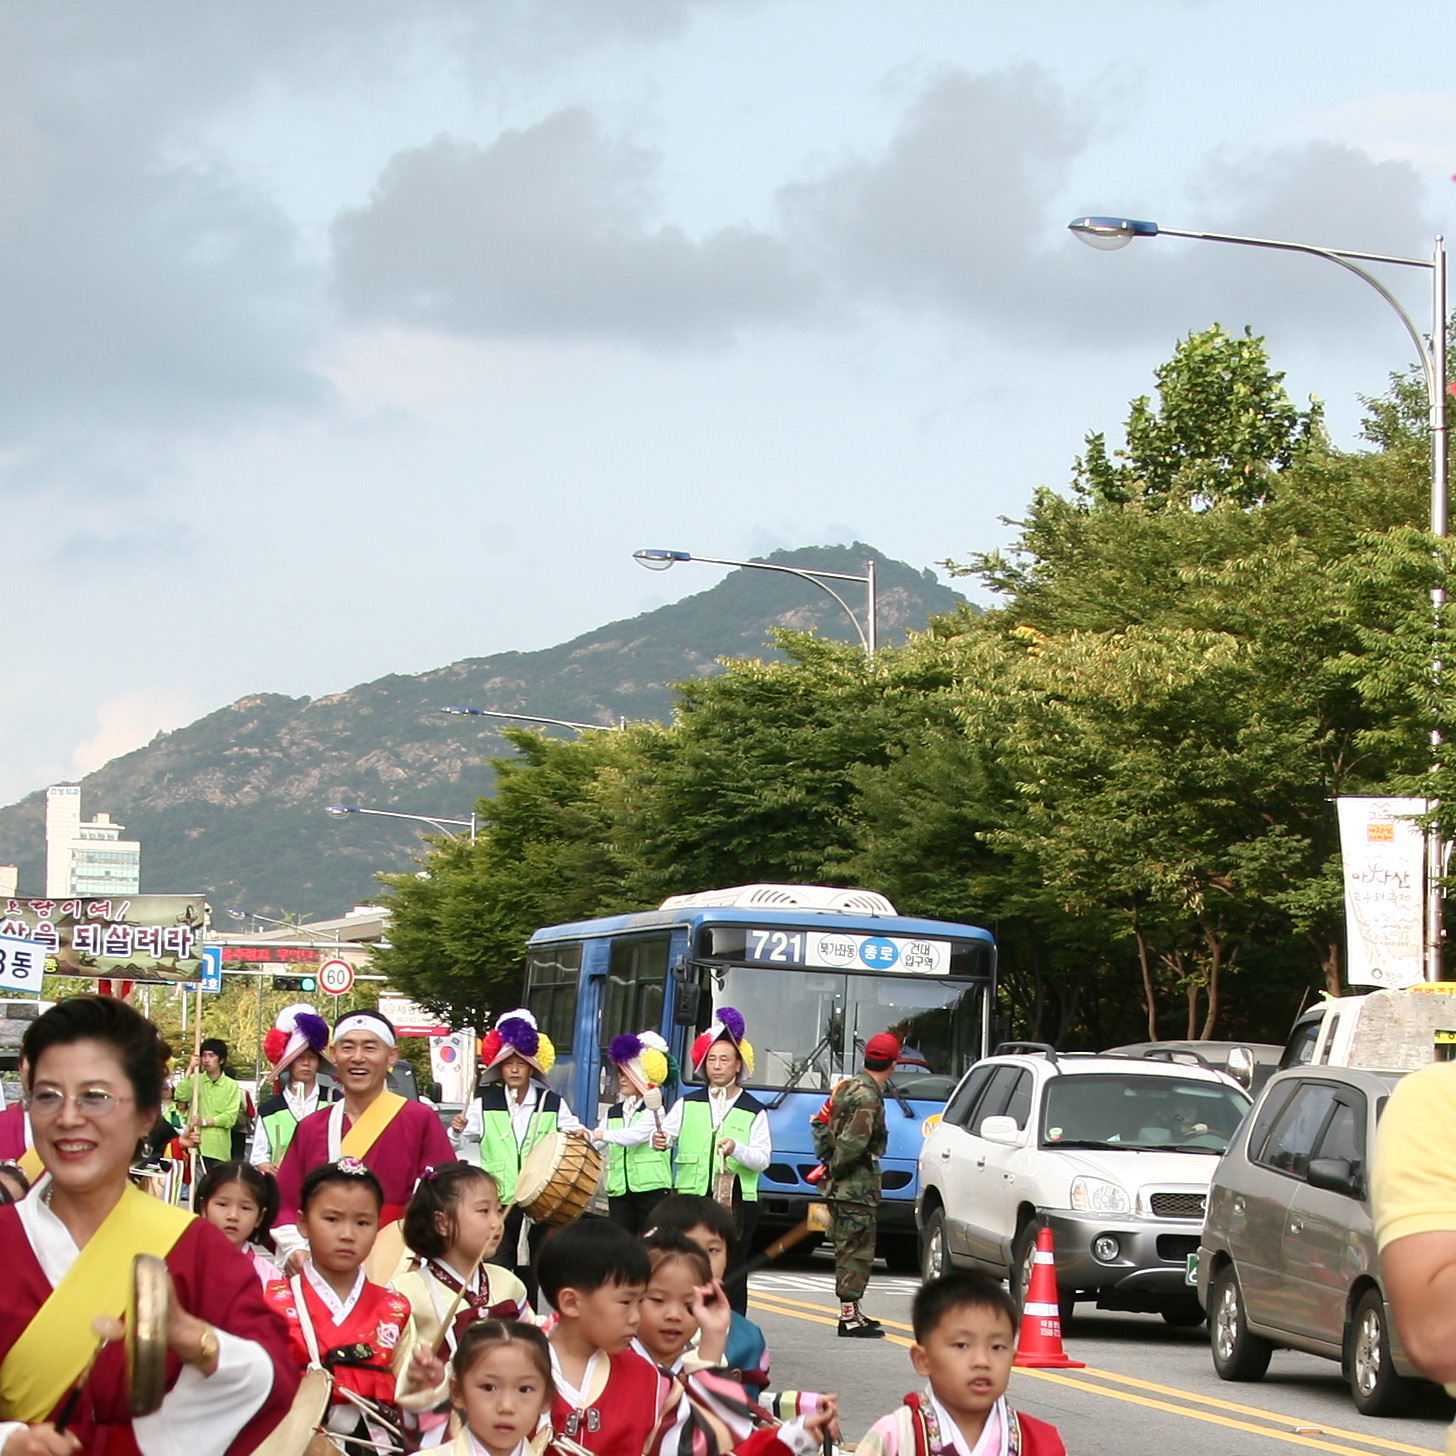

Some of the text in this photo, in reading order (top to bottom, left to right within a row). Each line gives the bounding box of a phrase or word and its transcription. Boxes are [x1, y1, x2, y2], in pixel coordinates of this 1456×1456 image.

[1352, 862, 1411, 889] 아차산
[73, 923, 194, 960] 되살려라
[752, 930, 801, 963] 721
[819, 941, 855, 959] 북가좌동
[910, 942, 931, 956] 건대
[863, 944, 894, 962] 종로
[905, 954, 934, 969] 입구역
[326, 969, 345, 985] 60
